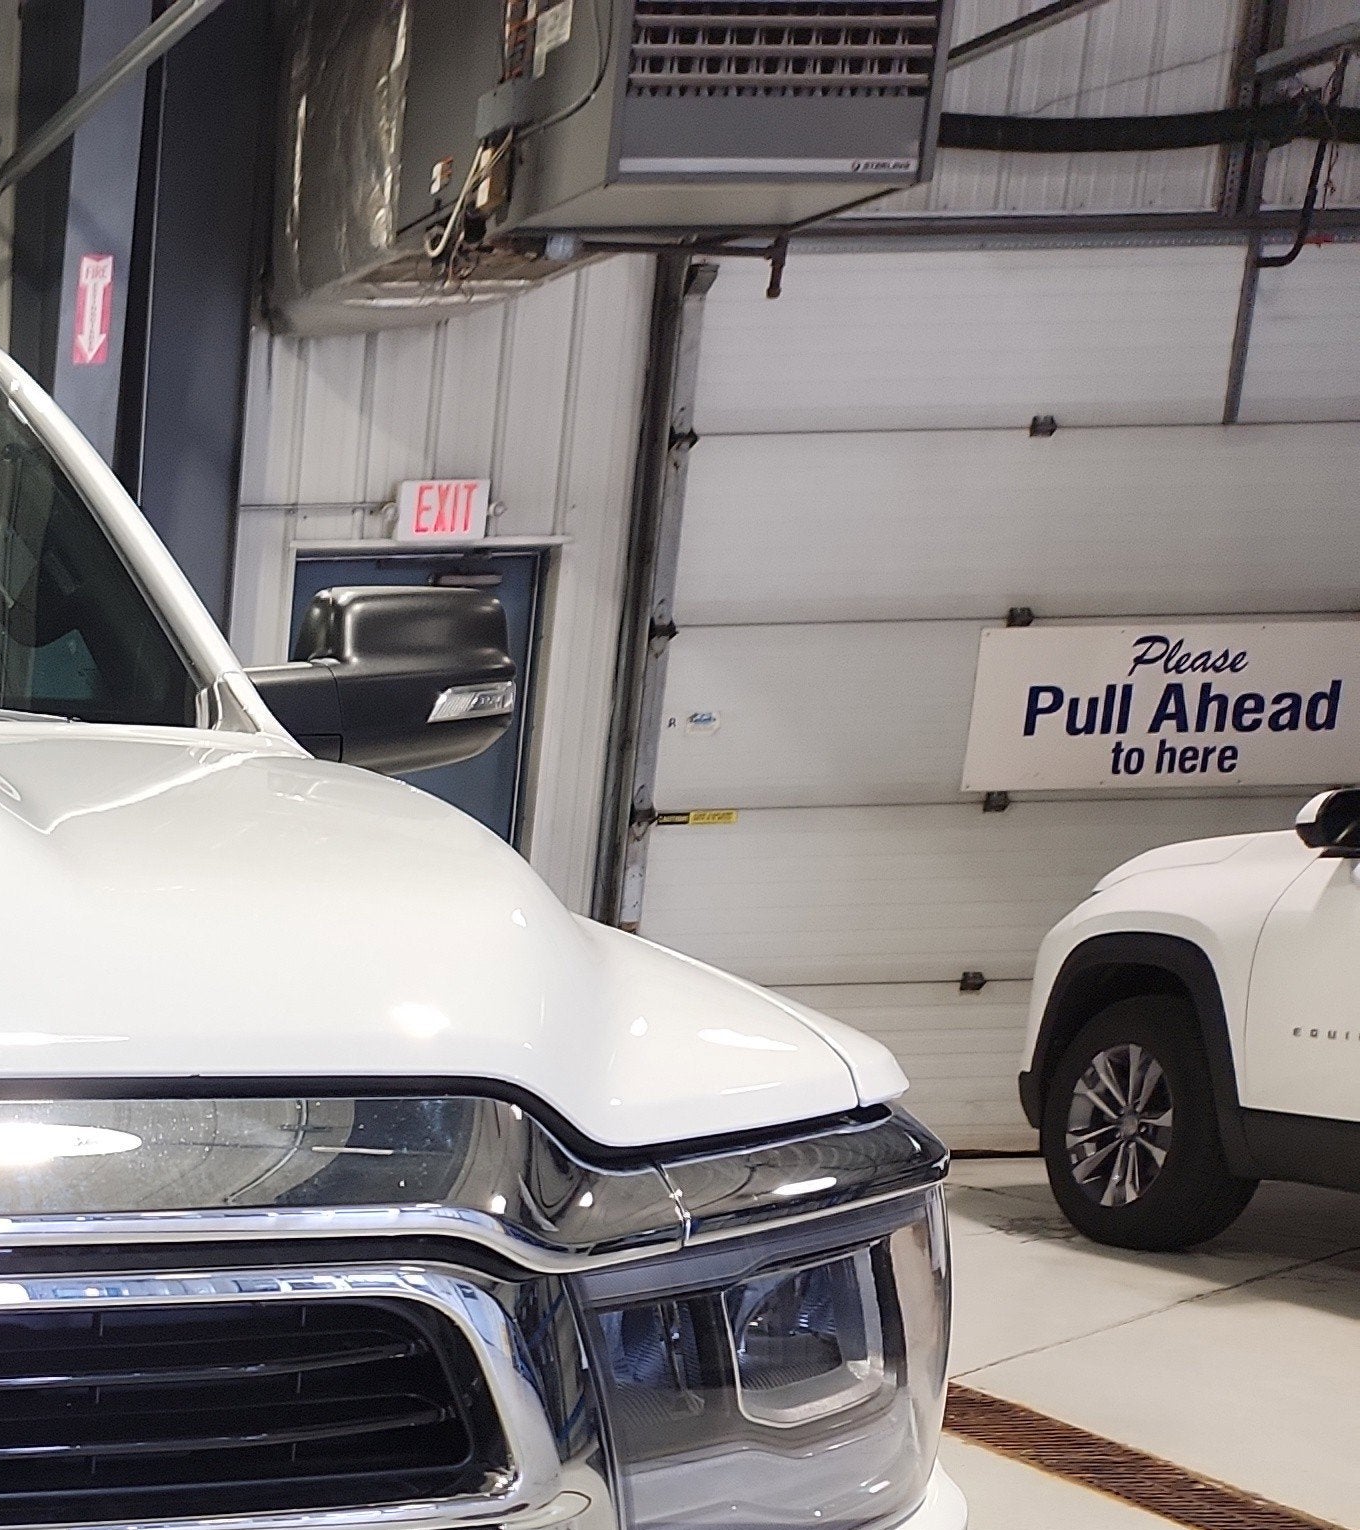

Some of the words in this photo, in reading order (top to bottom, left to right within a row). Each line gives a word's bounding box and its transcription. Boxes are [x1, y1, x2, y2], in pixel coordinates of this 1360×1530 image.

[85, 265, 109, 280] FIRE
[414, 484, 477, 533] EXIT
[1127, 634, 1248, 676] Please
[1022, 683, 1133, 737] Pull
[1147, 679, 1342, 734] Ahead
[1110, 741, 1145, 775] to
[1154, 739, 1239, 774] here
[1293, 1027, 1360, 1041] EQUI
